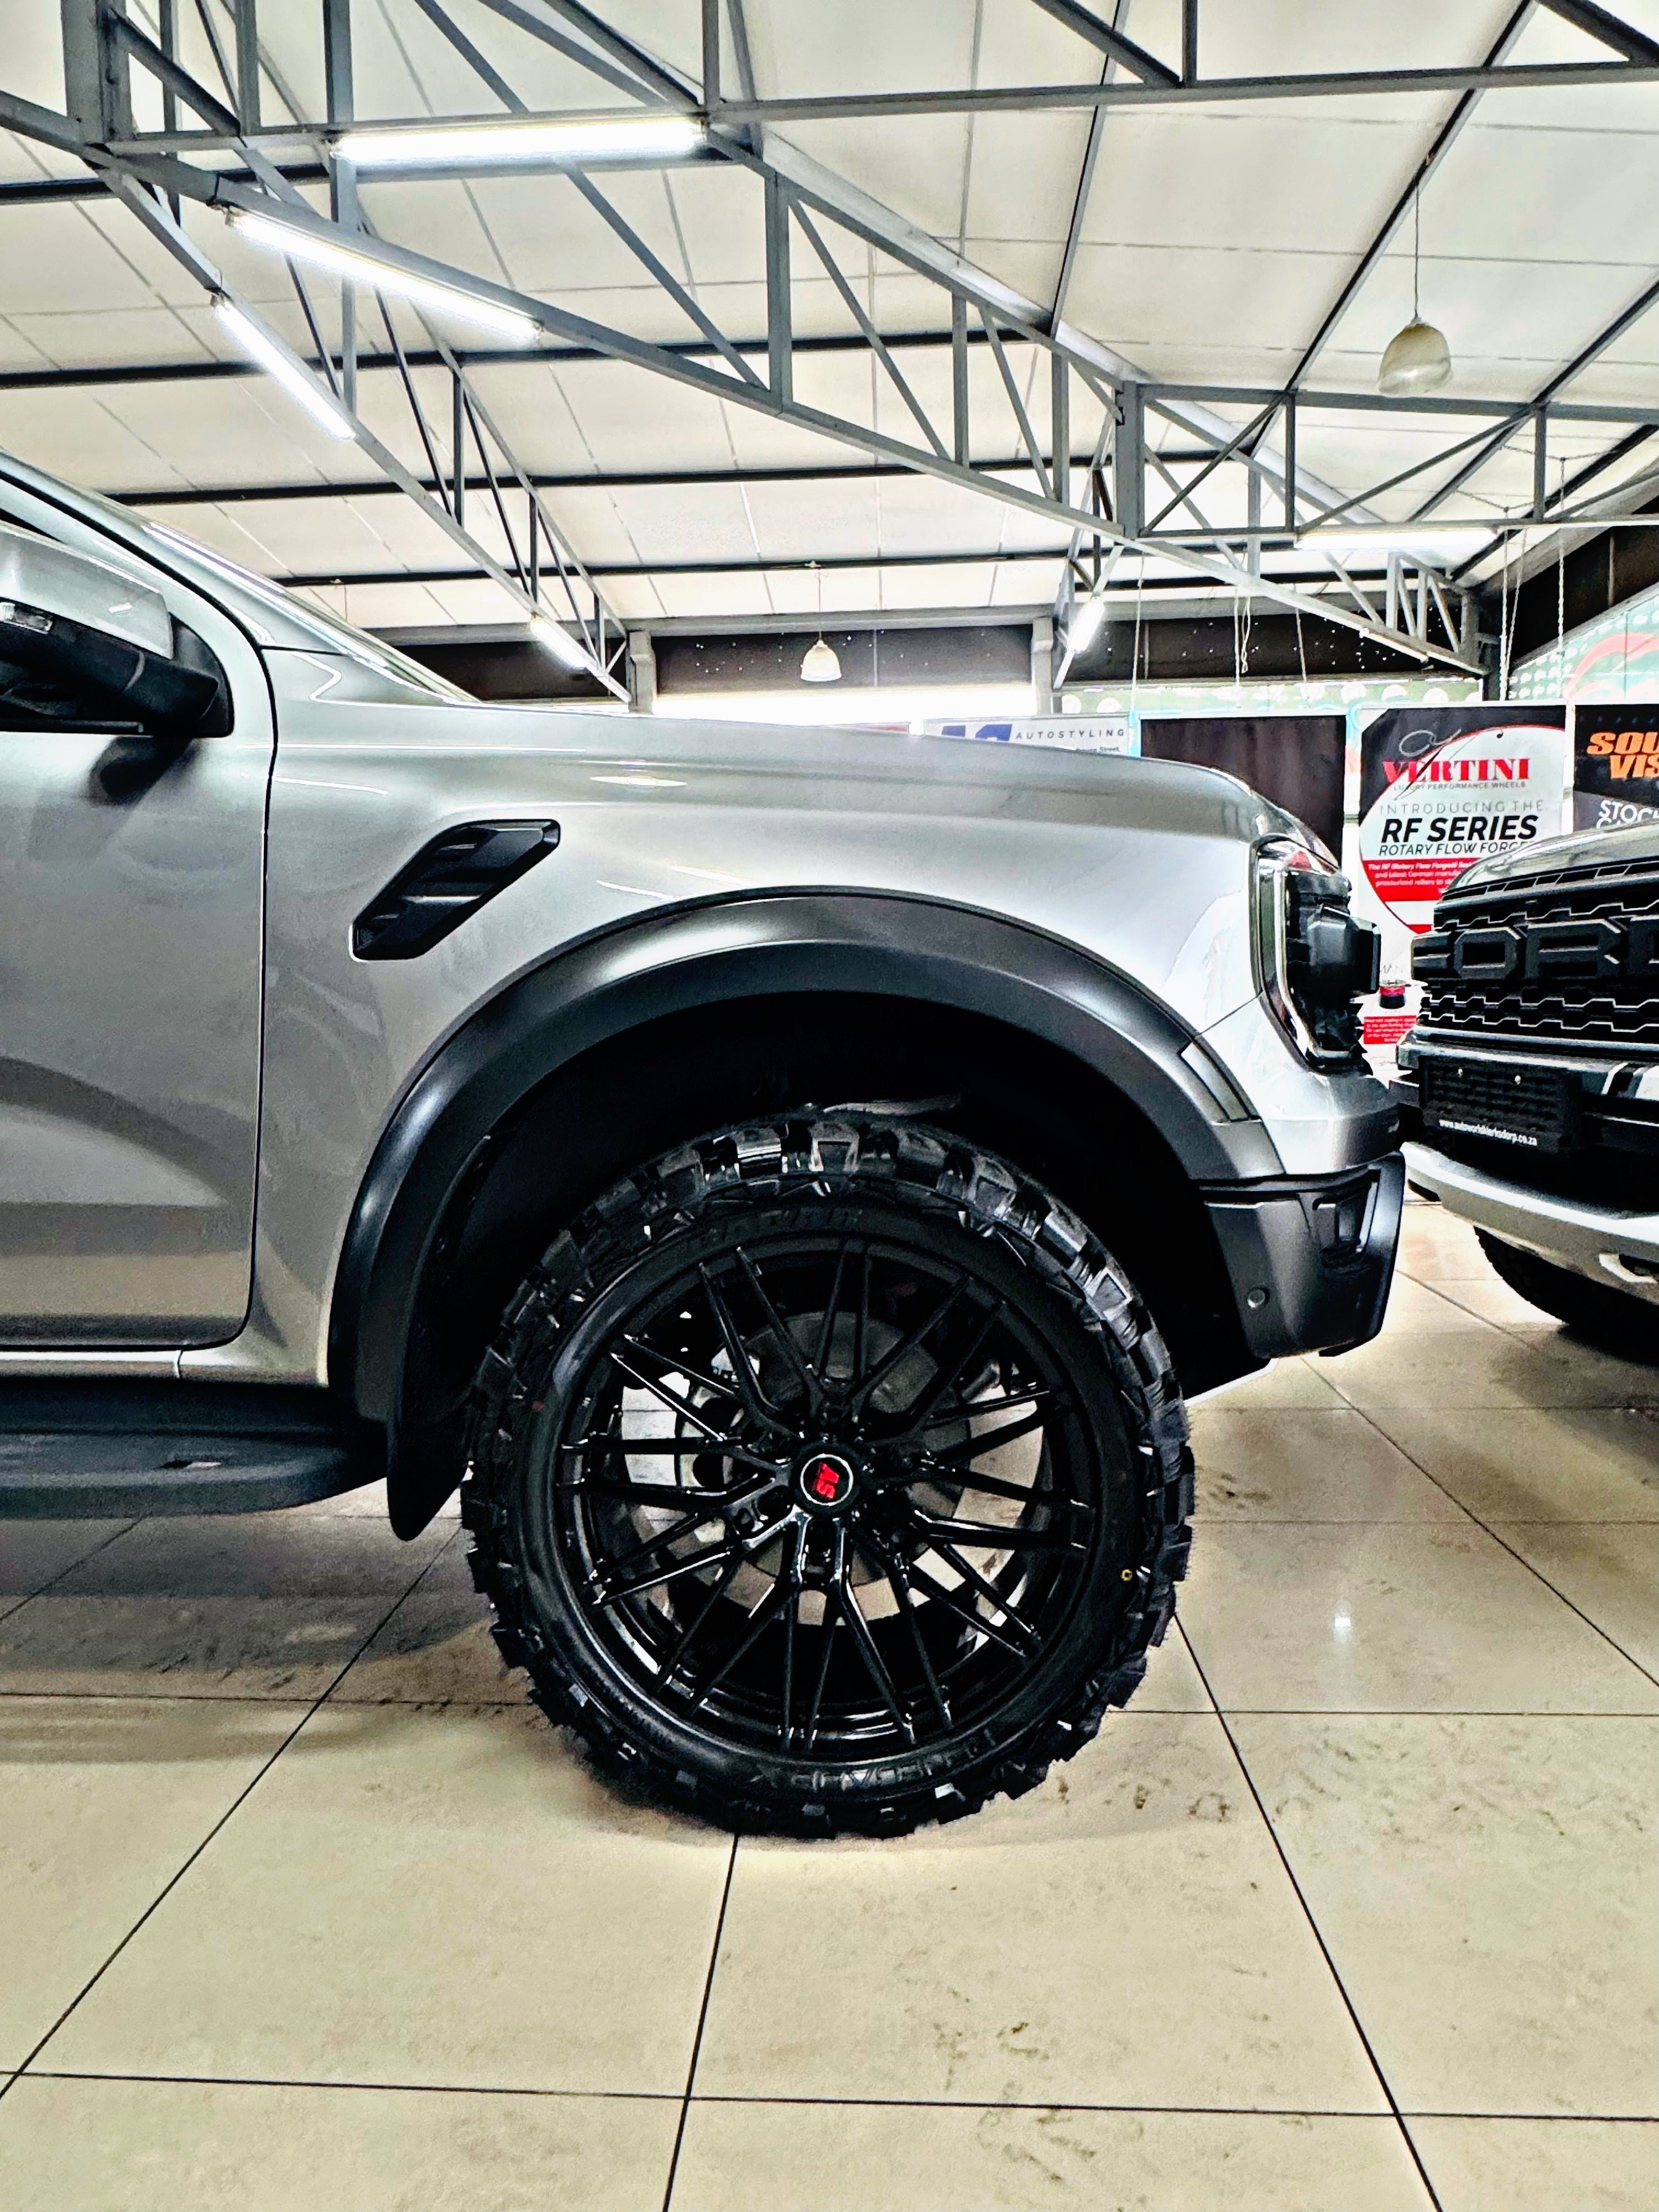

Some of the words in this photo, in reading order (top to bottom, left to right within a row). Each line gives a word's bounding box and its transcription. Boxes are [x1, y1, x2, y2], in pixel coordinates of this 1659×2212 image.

[1015, 729, 1125, 740] AUTOSTYLING
[1383, 758, 1531, 783] VERTINI
[1427, 782, 1489, 790] PERFORMANCE
[1380, 801, 1505, 815] INTRODUCING
[1512, 800, 1544, 812] THE
[1381, 818, 1423, 843] RF
[1427, 815, 1540, 842] SERIES
[1379, 844, 1434, 856] ROTARY
[1436, 842, 1478, 855] FLOW
